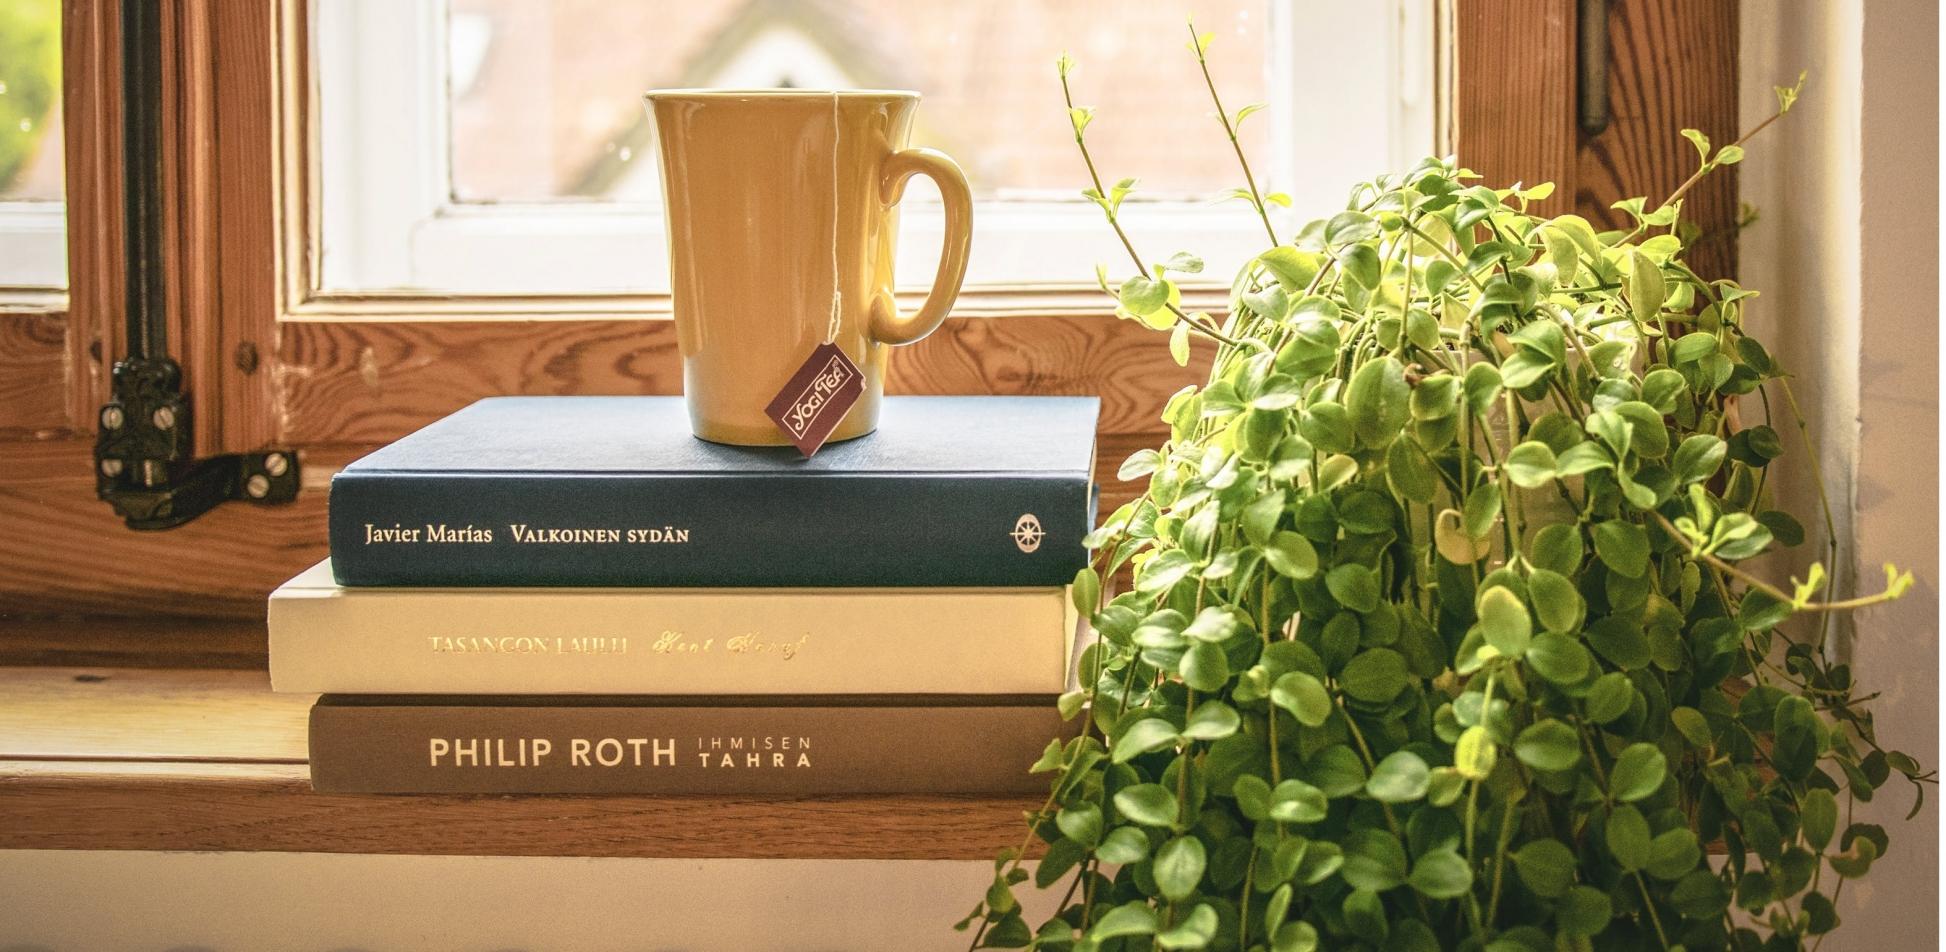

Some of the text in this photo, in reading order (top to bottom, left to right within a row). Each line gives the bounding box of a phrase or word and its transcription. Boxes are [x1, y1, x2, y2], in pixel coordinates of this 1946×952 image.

[791, 366, 844, 431] YOGI TEA
[364, 523, 690, 544] Javier Marías VALKOINEN SYDÄN
[430, 738, 676, 766] PHILIP ROTH
[698, 736, 811, 749] IHMISEN
[698, 752, 812, 768] TAHRA
